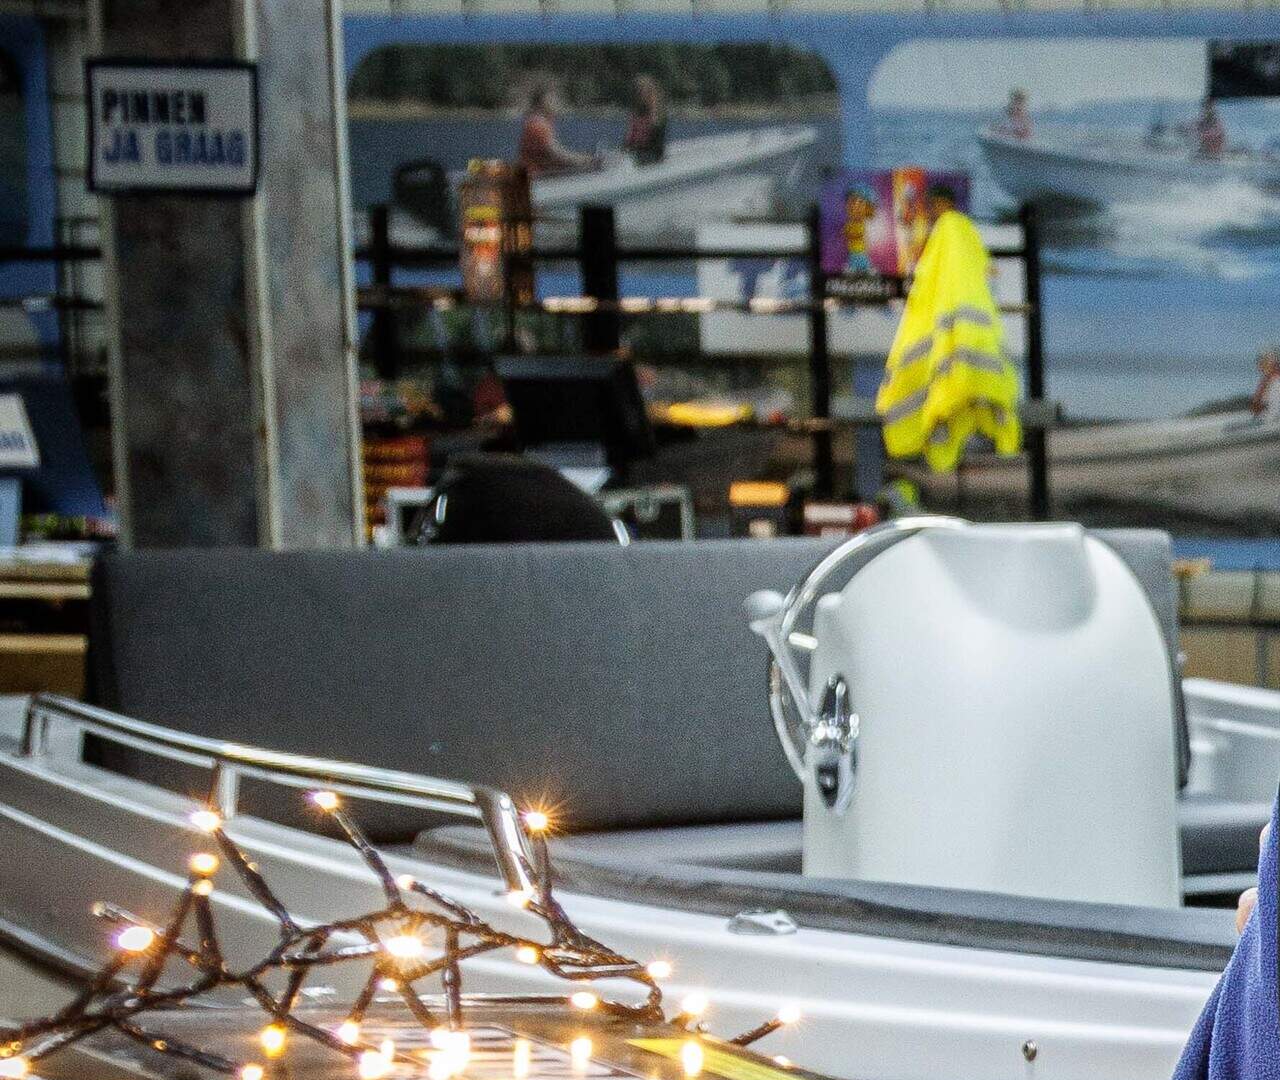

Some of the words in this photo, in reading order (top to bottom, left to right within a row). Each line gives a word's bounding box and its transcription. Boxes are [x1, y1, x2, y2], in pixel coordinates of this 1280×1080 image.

[102, 88, 206, 124] PINNEN
[102, 128, 141, 165] JA
[156, 126, 246, 167] GRAAG
